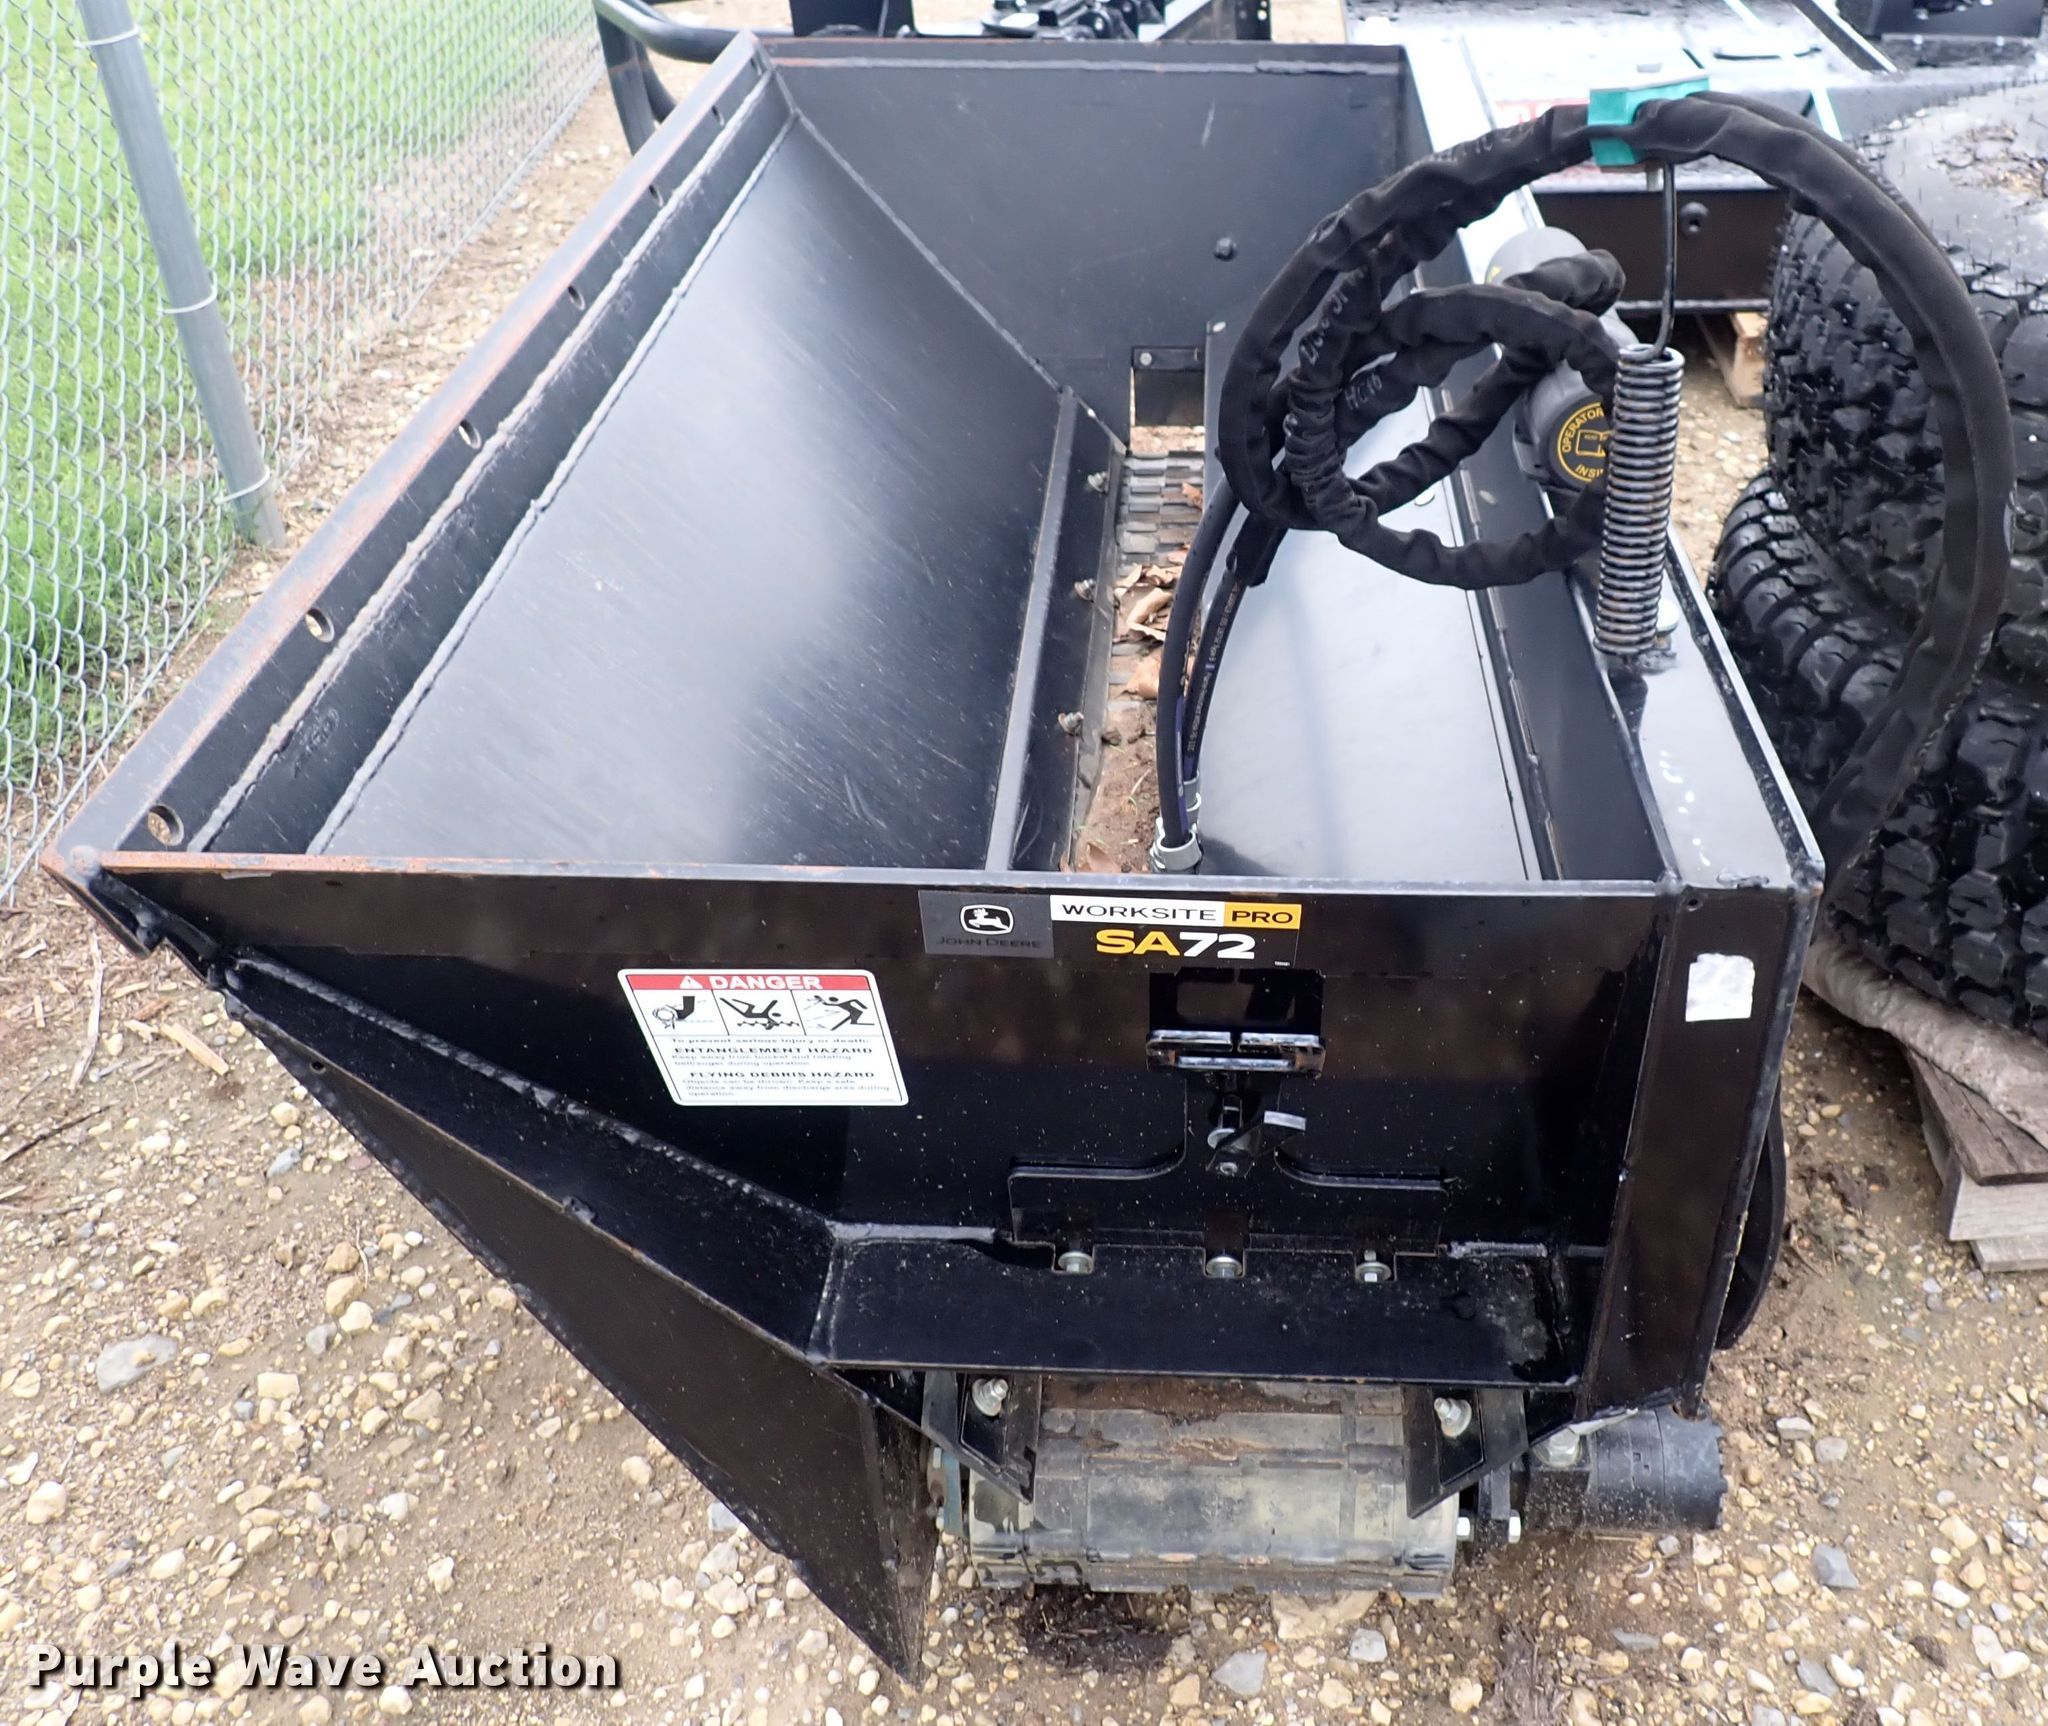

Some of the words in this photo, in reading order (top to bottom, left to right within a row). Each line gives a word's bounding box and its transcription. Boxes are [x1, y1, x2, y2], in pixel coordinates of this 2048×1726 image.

[1062, 903, 1217, 921] WORKSITE
[1231, 909, 1294, 925] PRO
[1096, 928, 1256, 960] SA72
[709, 975, 823, 990] DANGER
